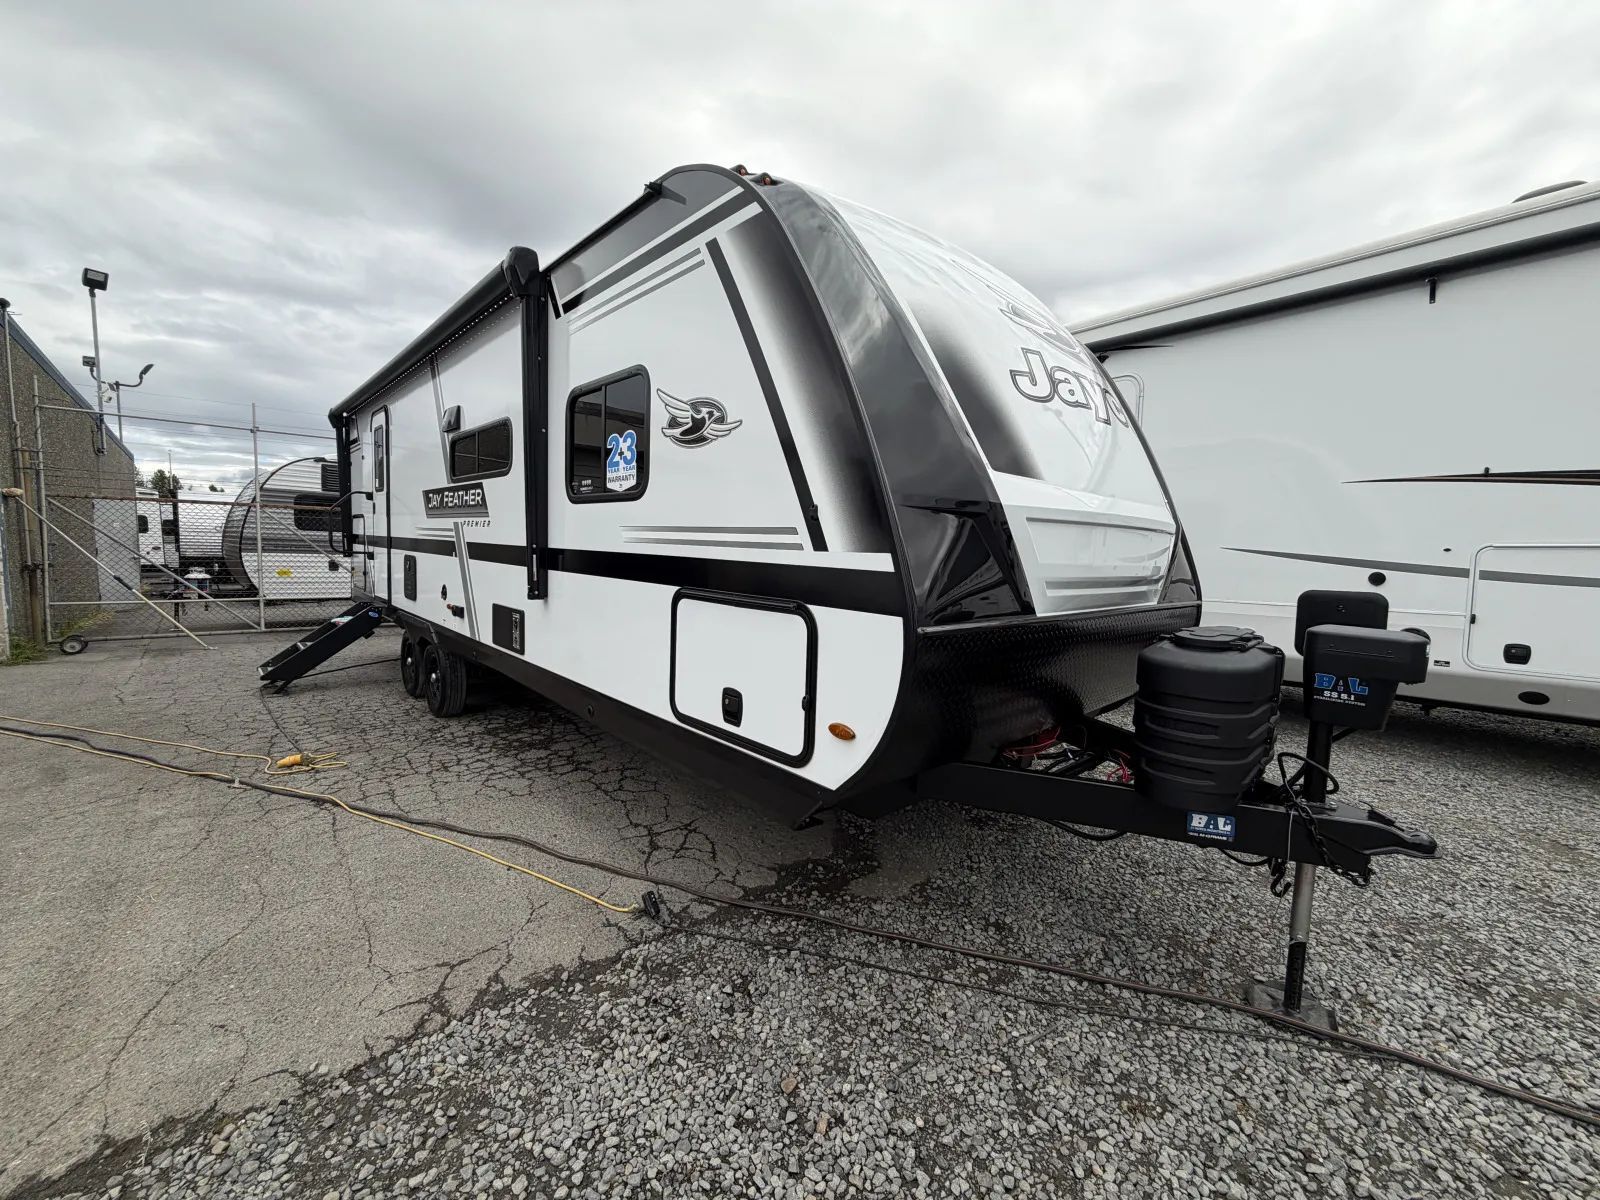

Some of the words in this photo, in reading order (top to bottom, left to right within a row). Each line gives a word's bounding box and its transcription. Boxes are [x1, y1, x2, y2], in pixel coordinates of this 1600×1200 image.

[608, 474, 636, 484] WARRANTY
[428, 493, 442, 508] JAY
[443, 489, 483, 507] FEATHER
[462, 520, 491, 528] PREMIER
[1314, 672, 1369, 696] BAL
[1190, 813, 1232, 831] BAL
